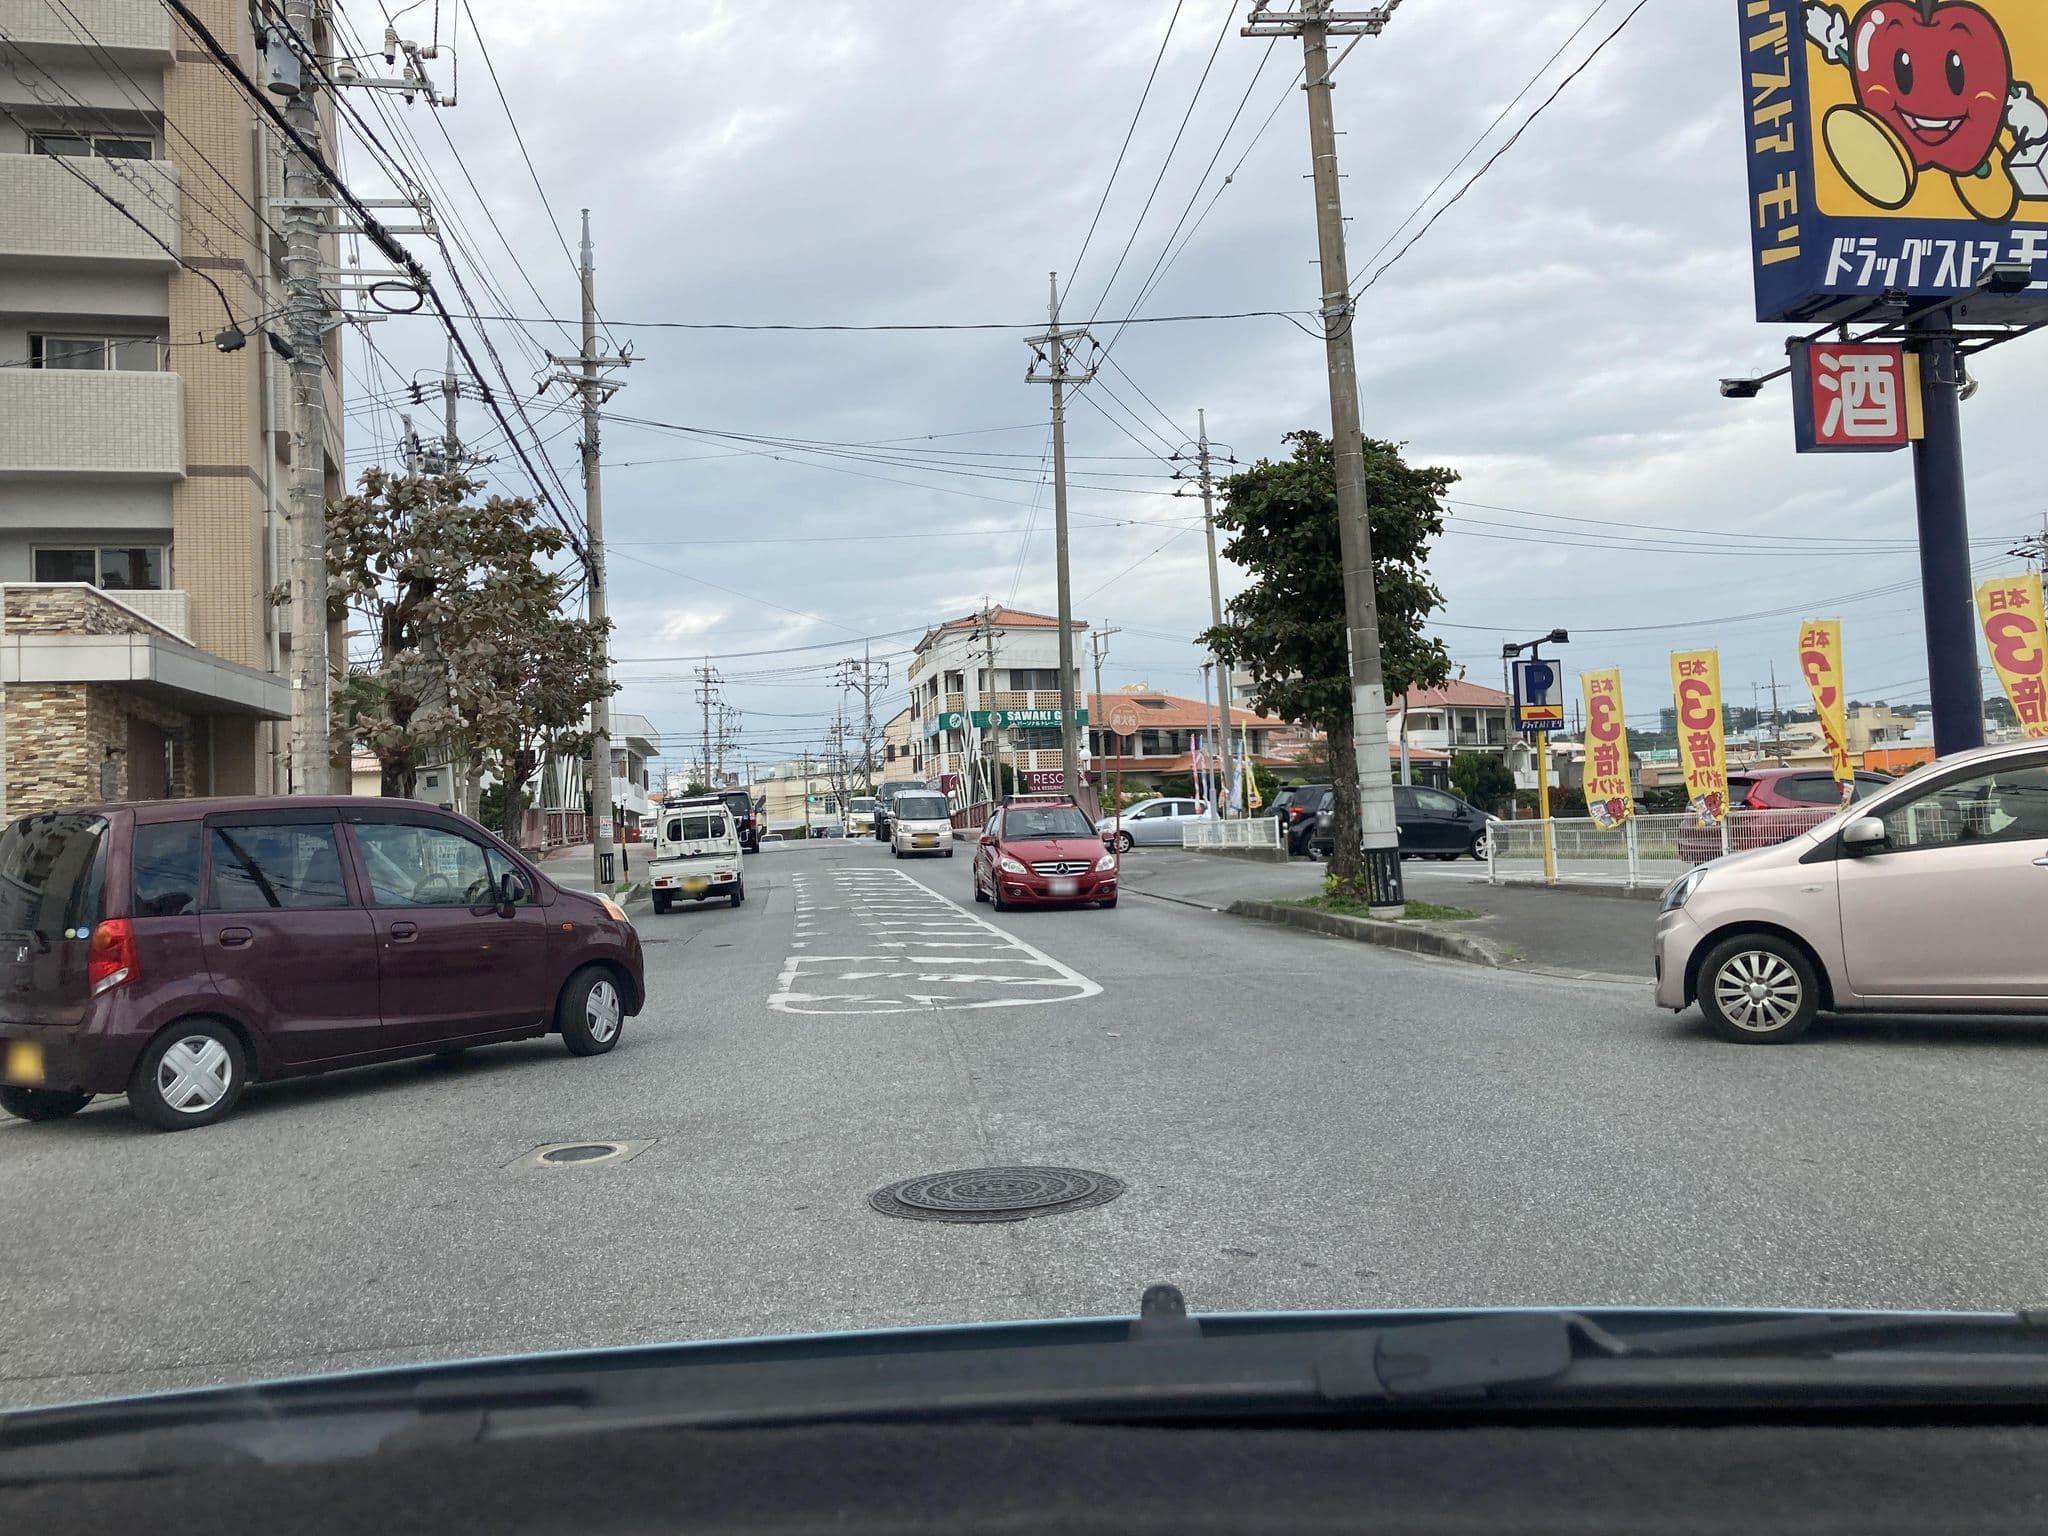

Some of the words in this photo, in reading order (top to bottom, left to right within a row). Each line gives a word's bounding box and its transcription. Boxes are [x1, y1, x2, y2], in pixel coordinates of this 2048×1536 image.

[1818, 353, 1898, 438] 酒
[1525, 664, 1554, 704] P
[1007, 710, 1051, 721] SAWAKI
